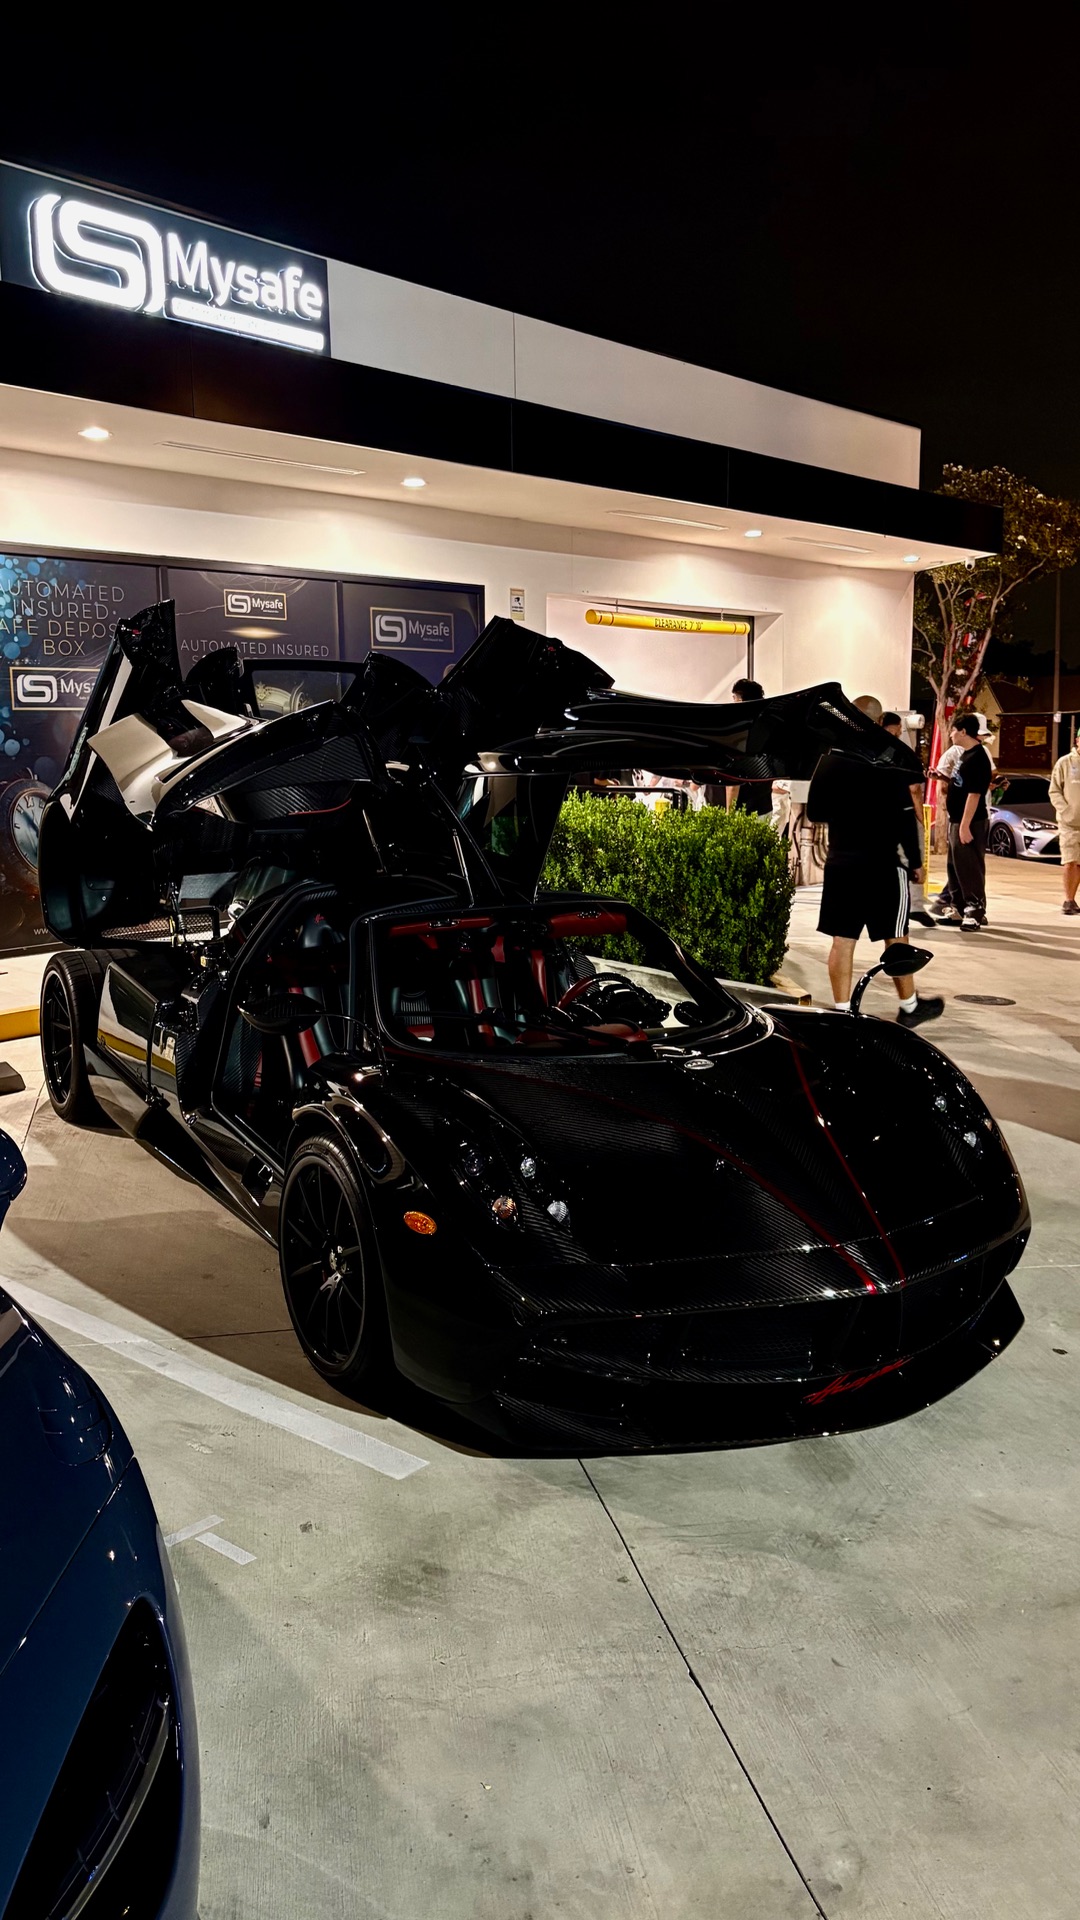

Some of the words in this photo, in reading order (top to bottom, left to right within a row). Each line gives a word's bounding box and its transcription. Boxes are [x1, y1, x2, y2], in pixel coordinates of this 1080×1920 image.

[166, 231, 323, 319] Mysafe
[13, 598, 109, 620] INSURED
[251, 597, 284, 611] Mysafe
[0, 618, 39, 636] AFE
[48, 620, 117, 639] DEPOS
[408, 620, 450, 638] Mysafe
[654, 618, 687, 630] CLEARANCE
[43, 638, 86, 657] BOX
[272, 643, 330, 657] INSURED
[61, 678, 95, 697] Mys
